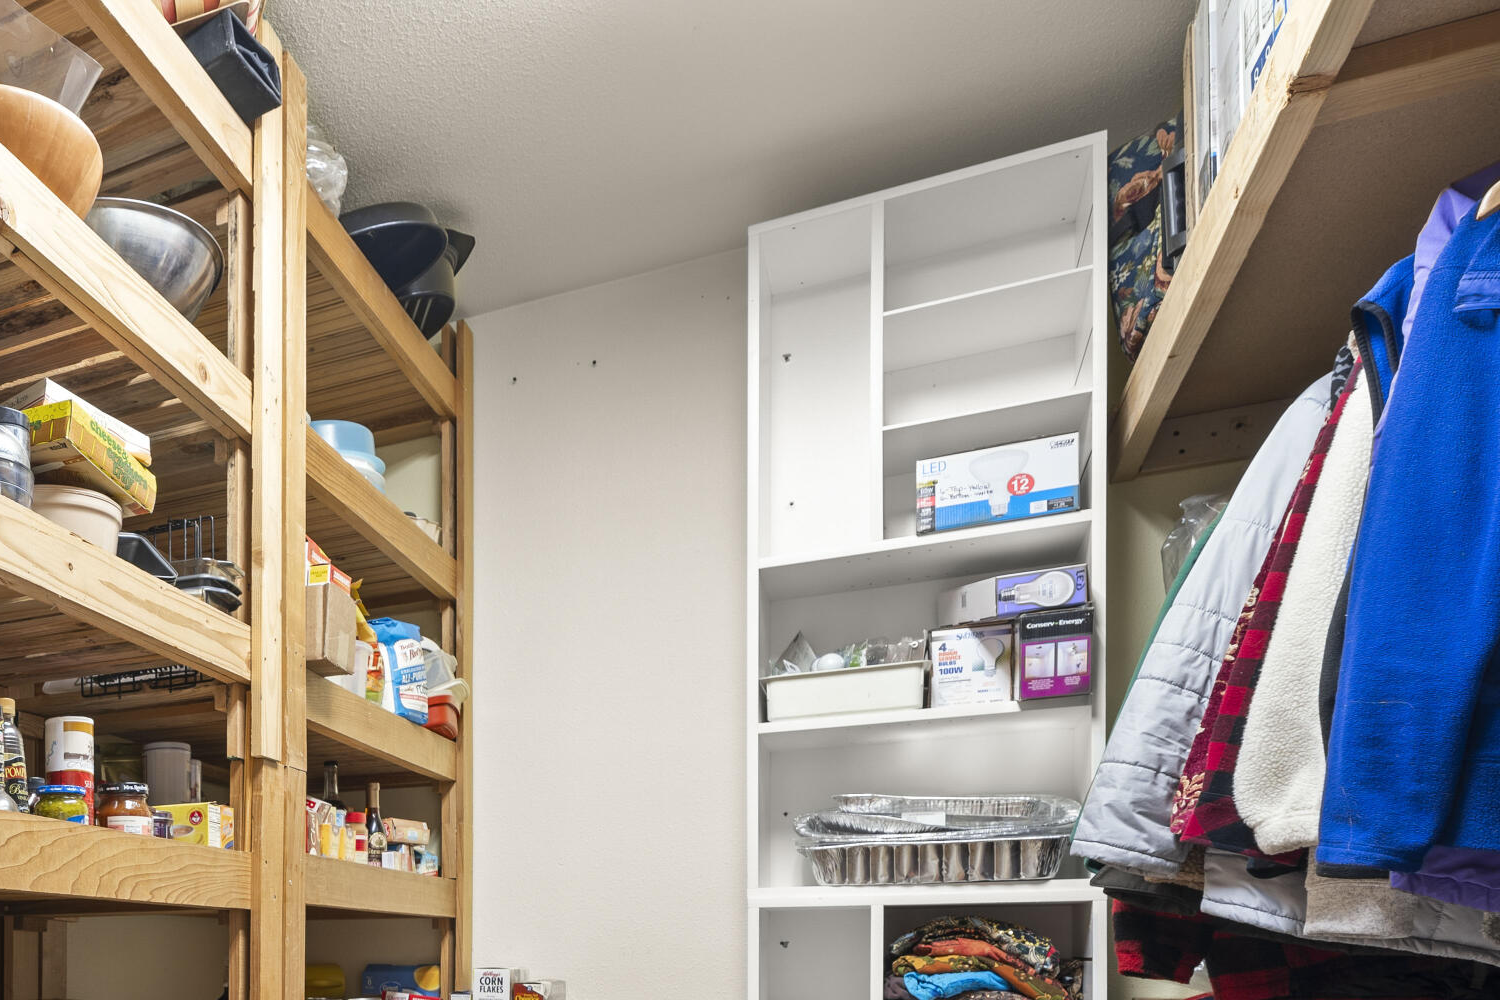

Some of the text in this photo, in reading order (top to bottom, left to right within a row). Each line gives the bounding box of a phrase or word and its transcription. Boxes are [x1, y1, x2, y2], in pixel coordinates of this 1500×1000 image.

[922, 460, 947, 475] LED
[112, 462, 136, 491] tray
[1011, 478, 1030, 491] 12
[1075, 569, 1085, 591] LED
[938, 643, 947, 652] 4
[938, 666, 963, 676] 100W
[479, 977, 504, 986] CORN
[479, 984, 504, 994] FLAKES
